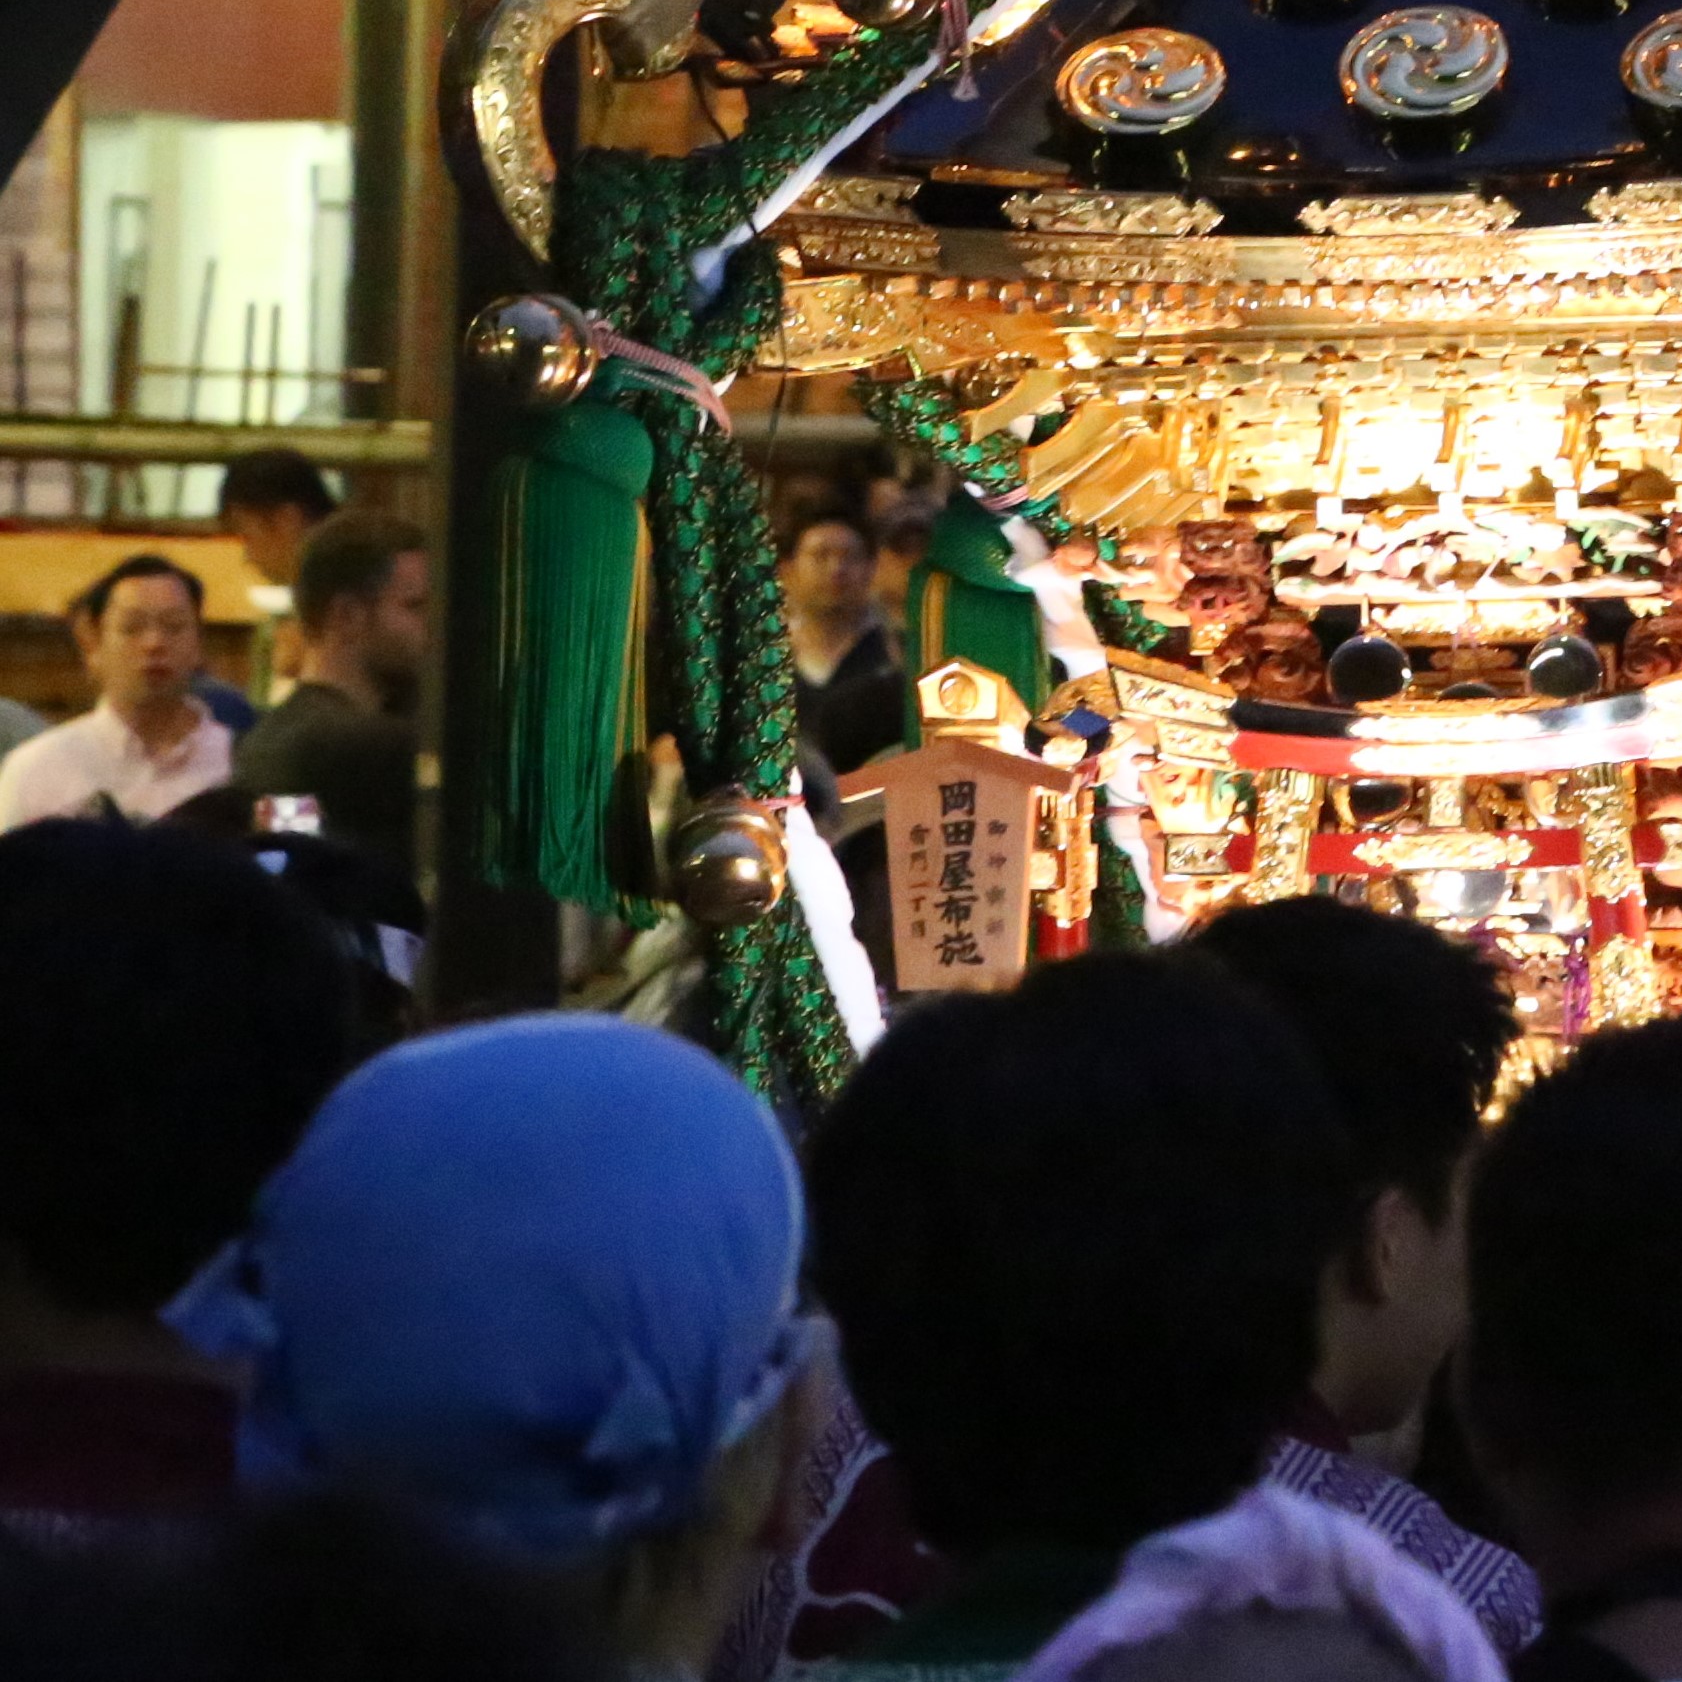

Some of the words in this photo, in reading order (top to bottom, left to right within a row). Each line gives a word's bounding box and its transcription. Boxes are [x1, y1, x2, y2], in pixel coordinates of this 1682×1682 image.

[933, 780, 985, 966] 岡田屋布施
